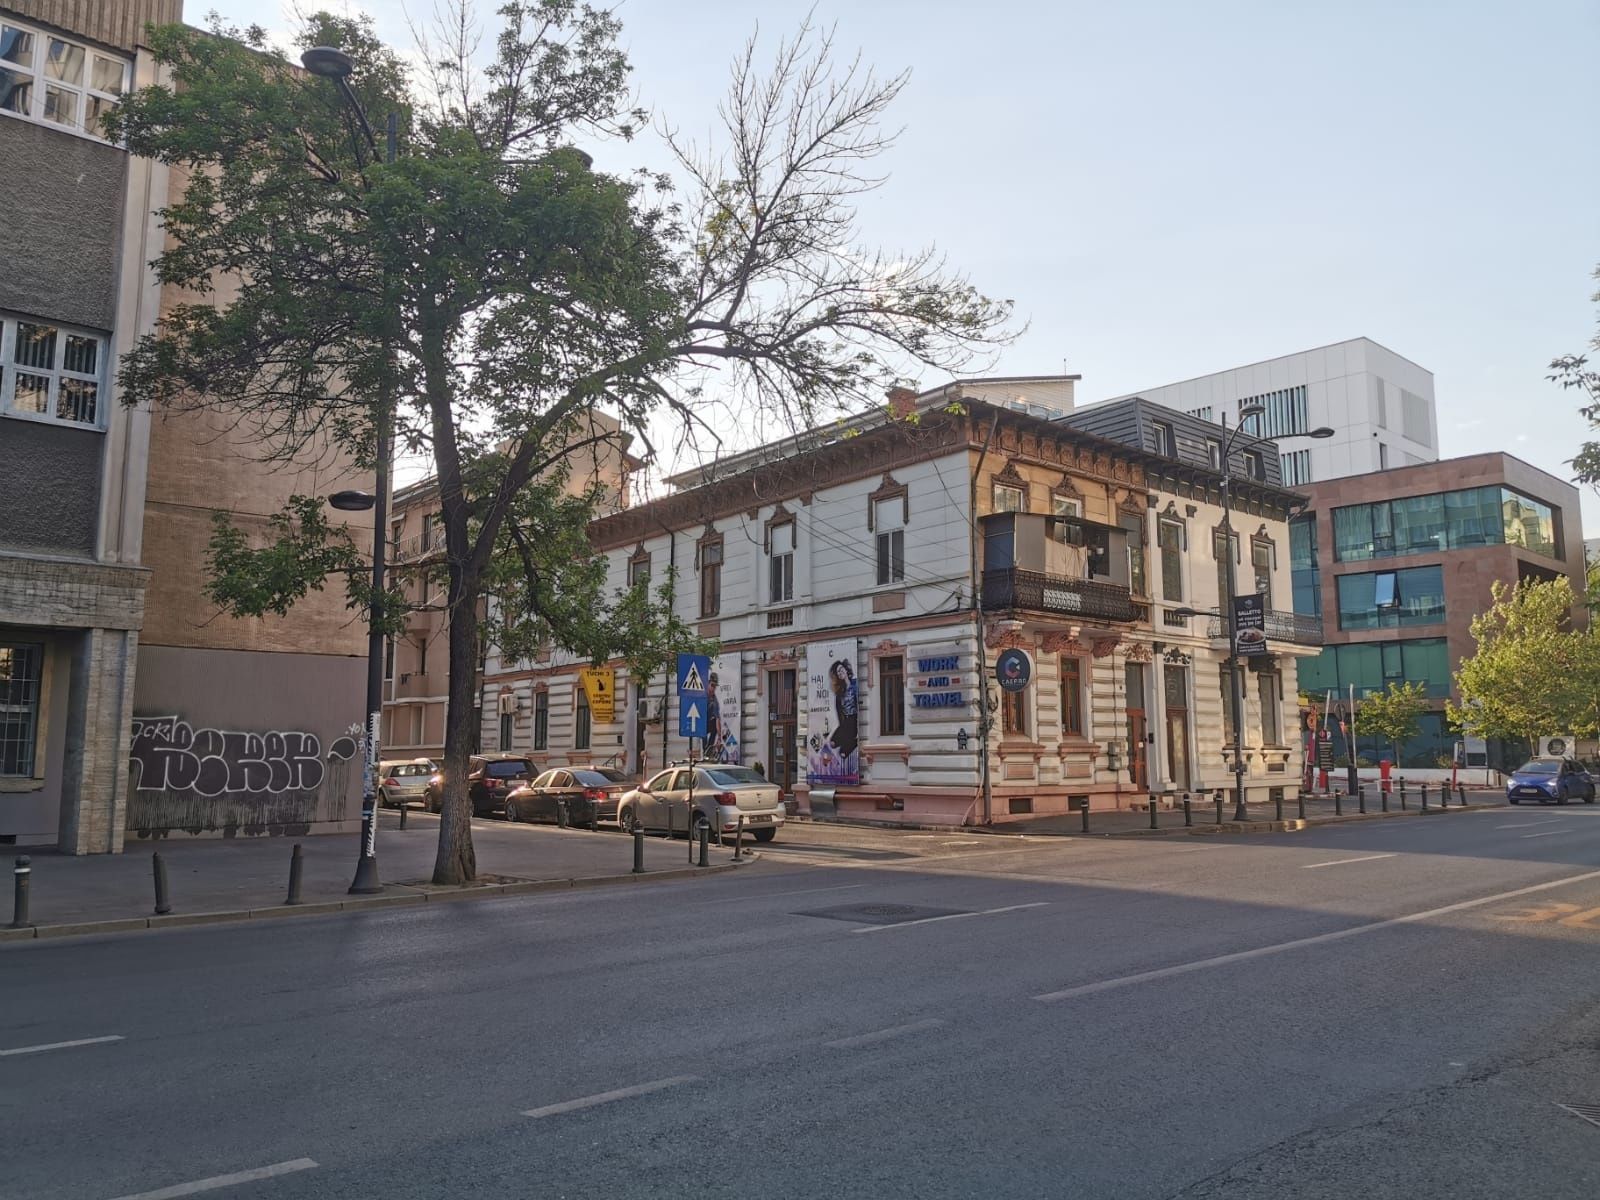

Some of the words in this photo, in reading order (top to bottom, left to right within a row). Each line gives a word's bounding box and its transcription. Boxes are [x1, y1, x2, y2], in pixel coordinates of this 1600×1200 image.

[917, 655, 960, 672] WORK
[810, 674, 824, 684] HAI
[927, 676, 950, 688] AND
[816, 689, 830, 698] NOI
[913, 692, 964, 707] TRAVEL
